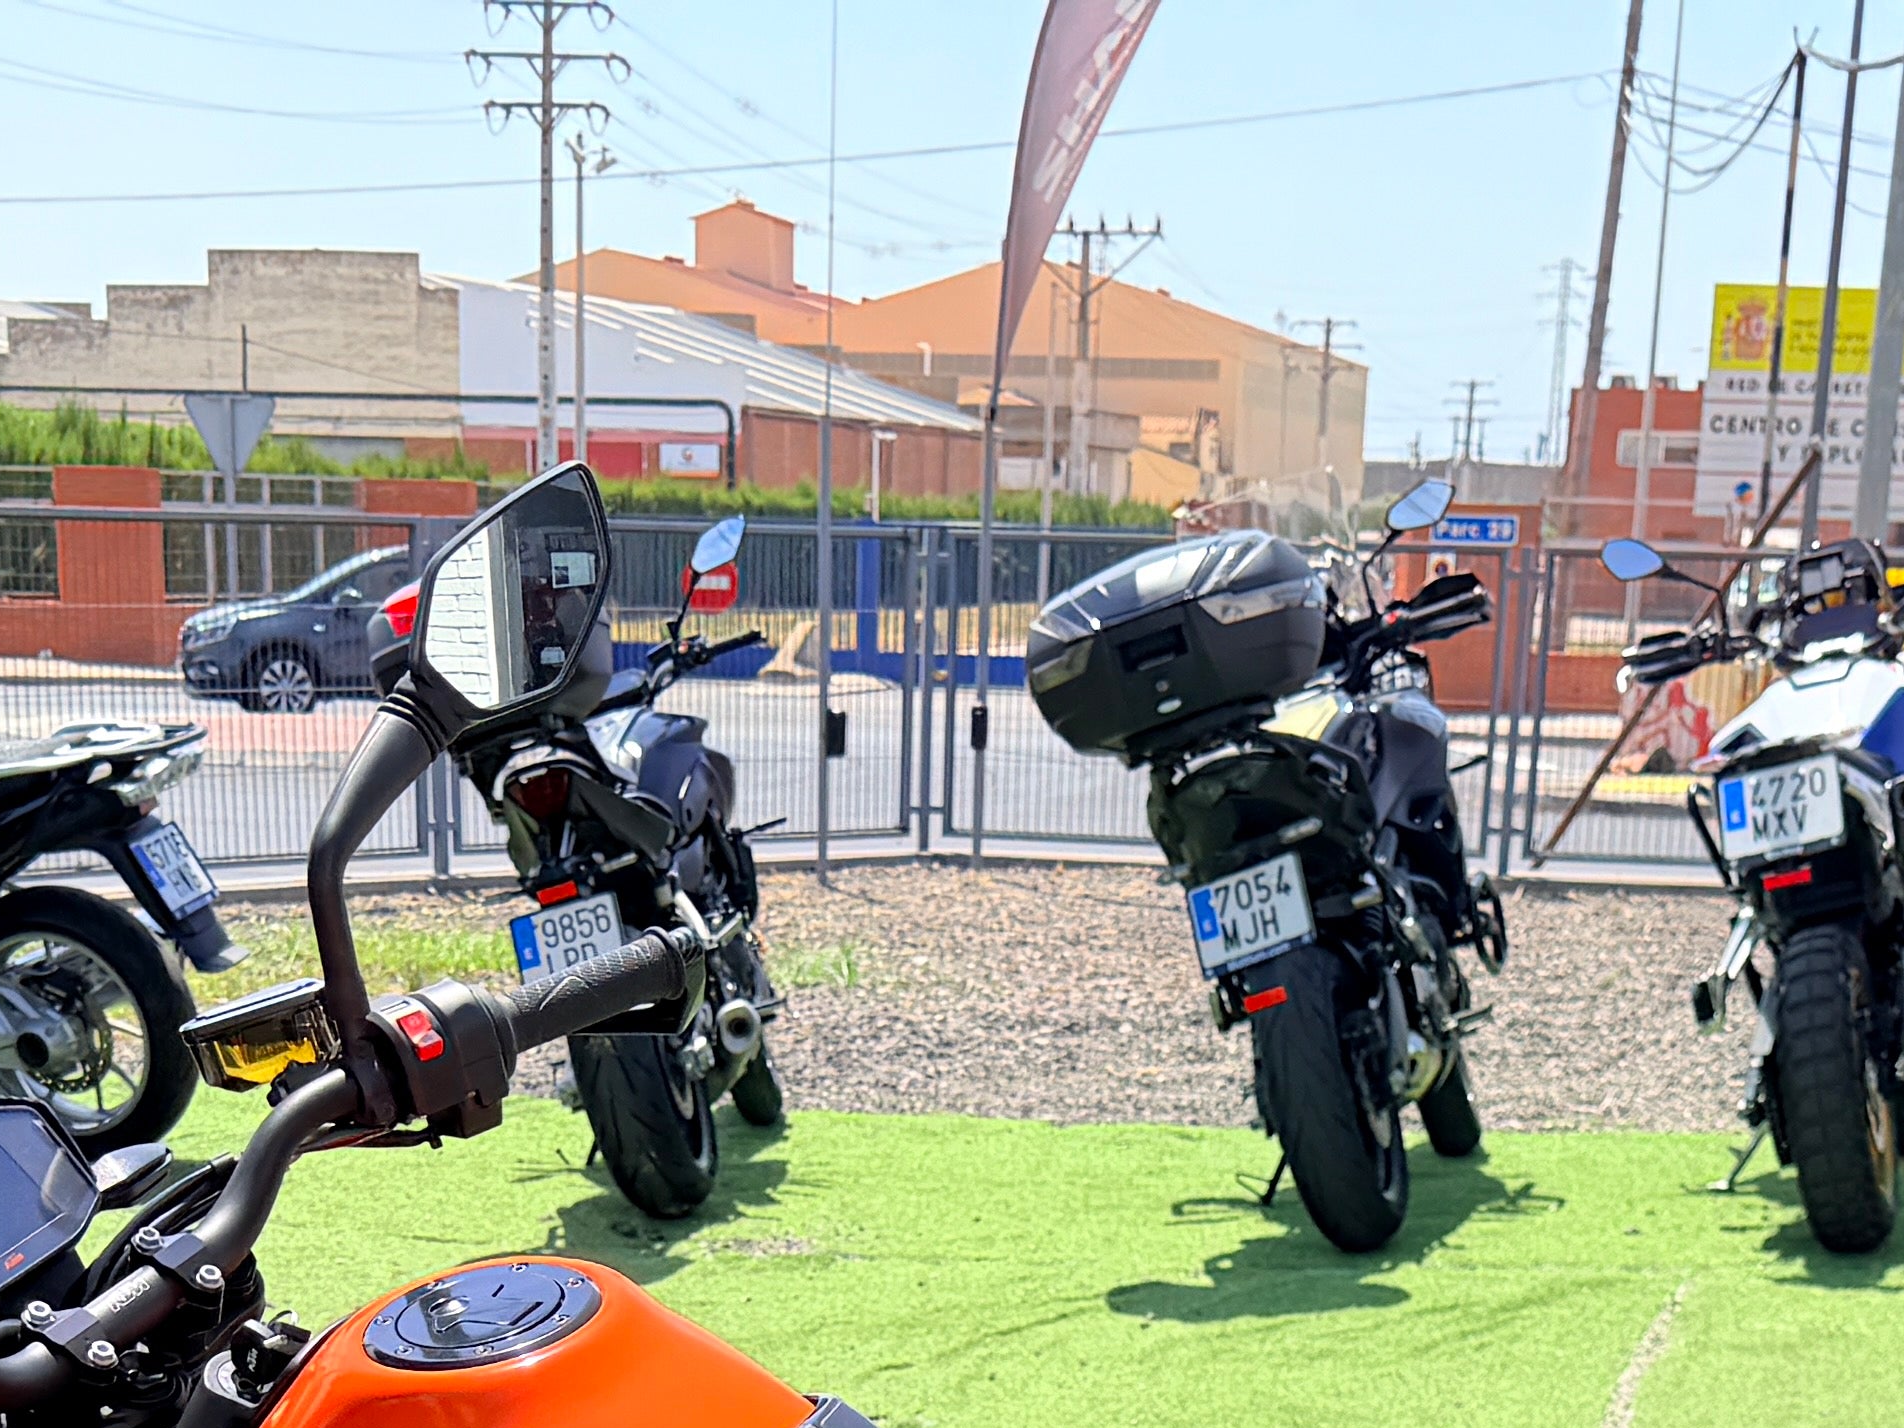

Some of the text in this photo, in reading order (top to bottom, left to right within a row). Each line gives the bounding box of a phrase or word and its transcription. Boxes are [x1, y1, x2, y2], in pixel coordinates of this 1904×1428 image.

[1752, 767, 1826, 807] 4720
[1752, 804, 1808, 842] MXV
[1214, 865, 1291, 918] 7054
[541, 903, 612, 948] 9856
[1221, 905, 1281, 952] MJH
